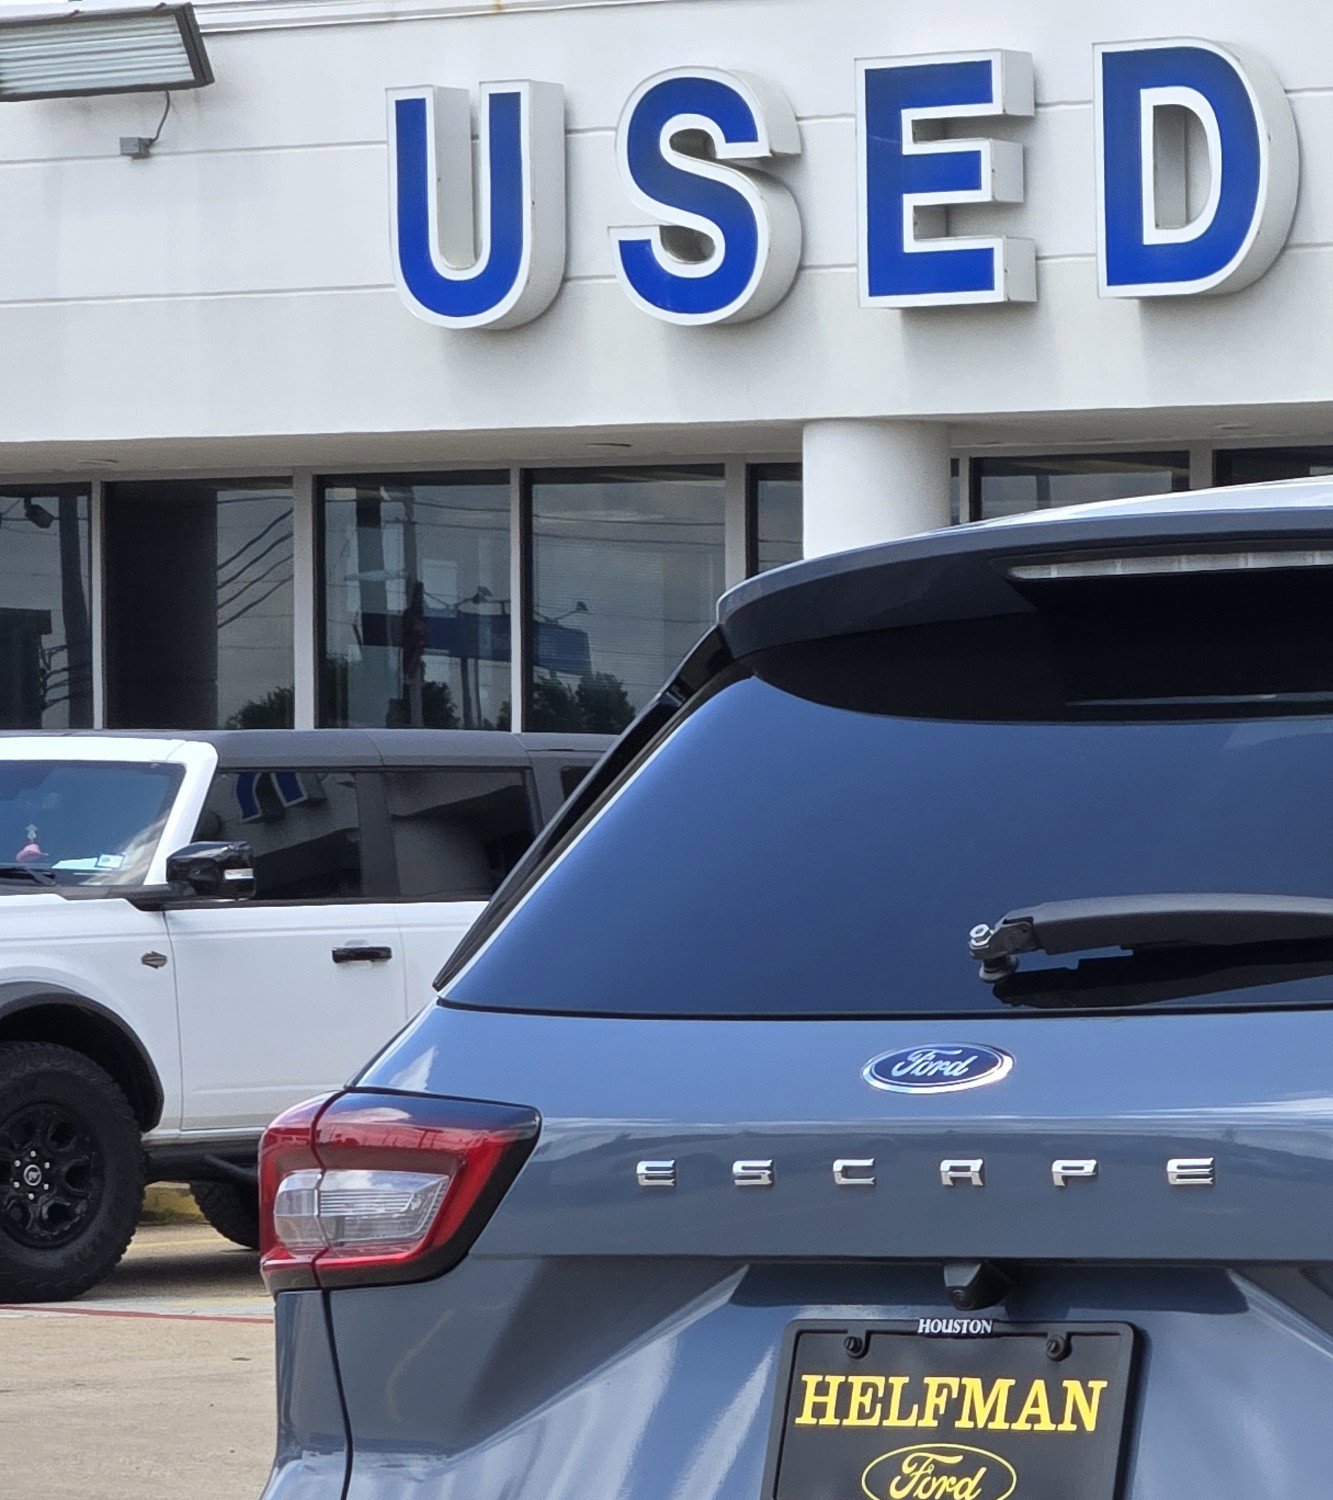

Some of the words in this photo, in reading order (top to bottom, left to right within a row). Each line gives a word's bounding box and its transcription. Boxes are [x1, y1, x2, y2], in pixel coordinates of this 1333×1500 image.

[384, 36, 1298, 331] USED
[635, 1157, 1217, 1187] ESCAPE
[917, 1318, 994, 1335] HOUSTON
[794, 1374, 1108, 1432] HELFMAN
